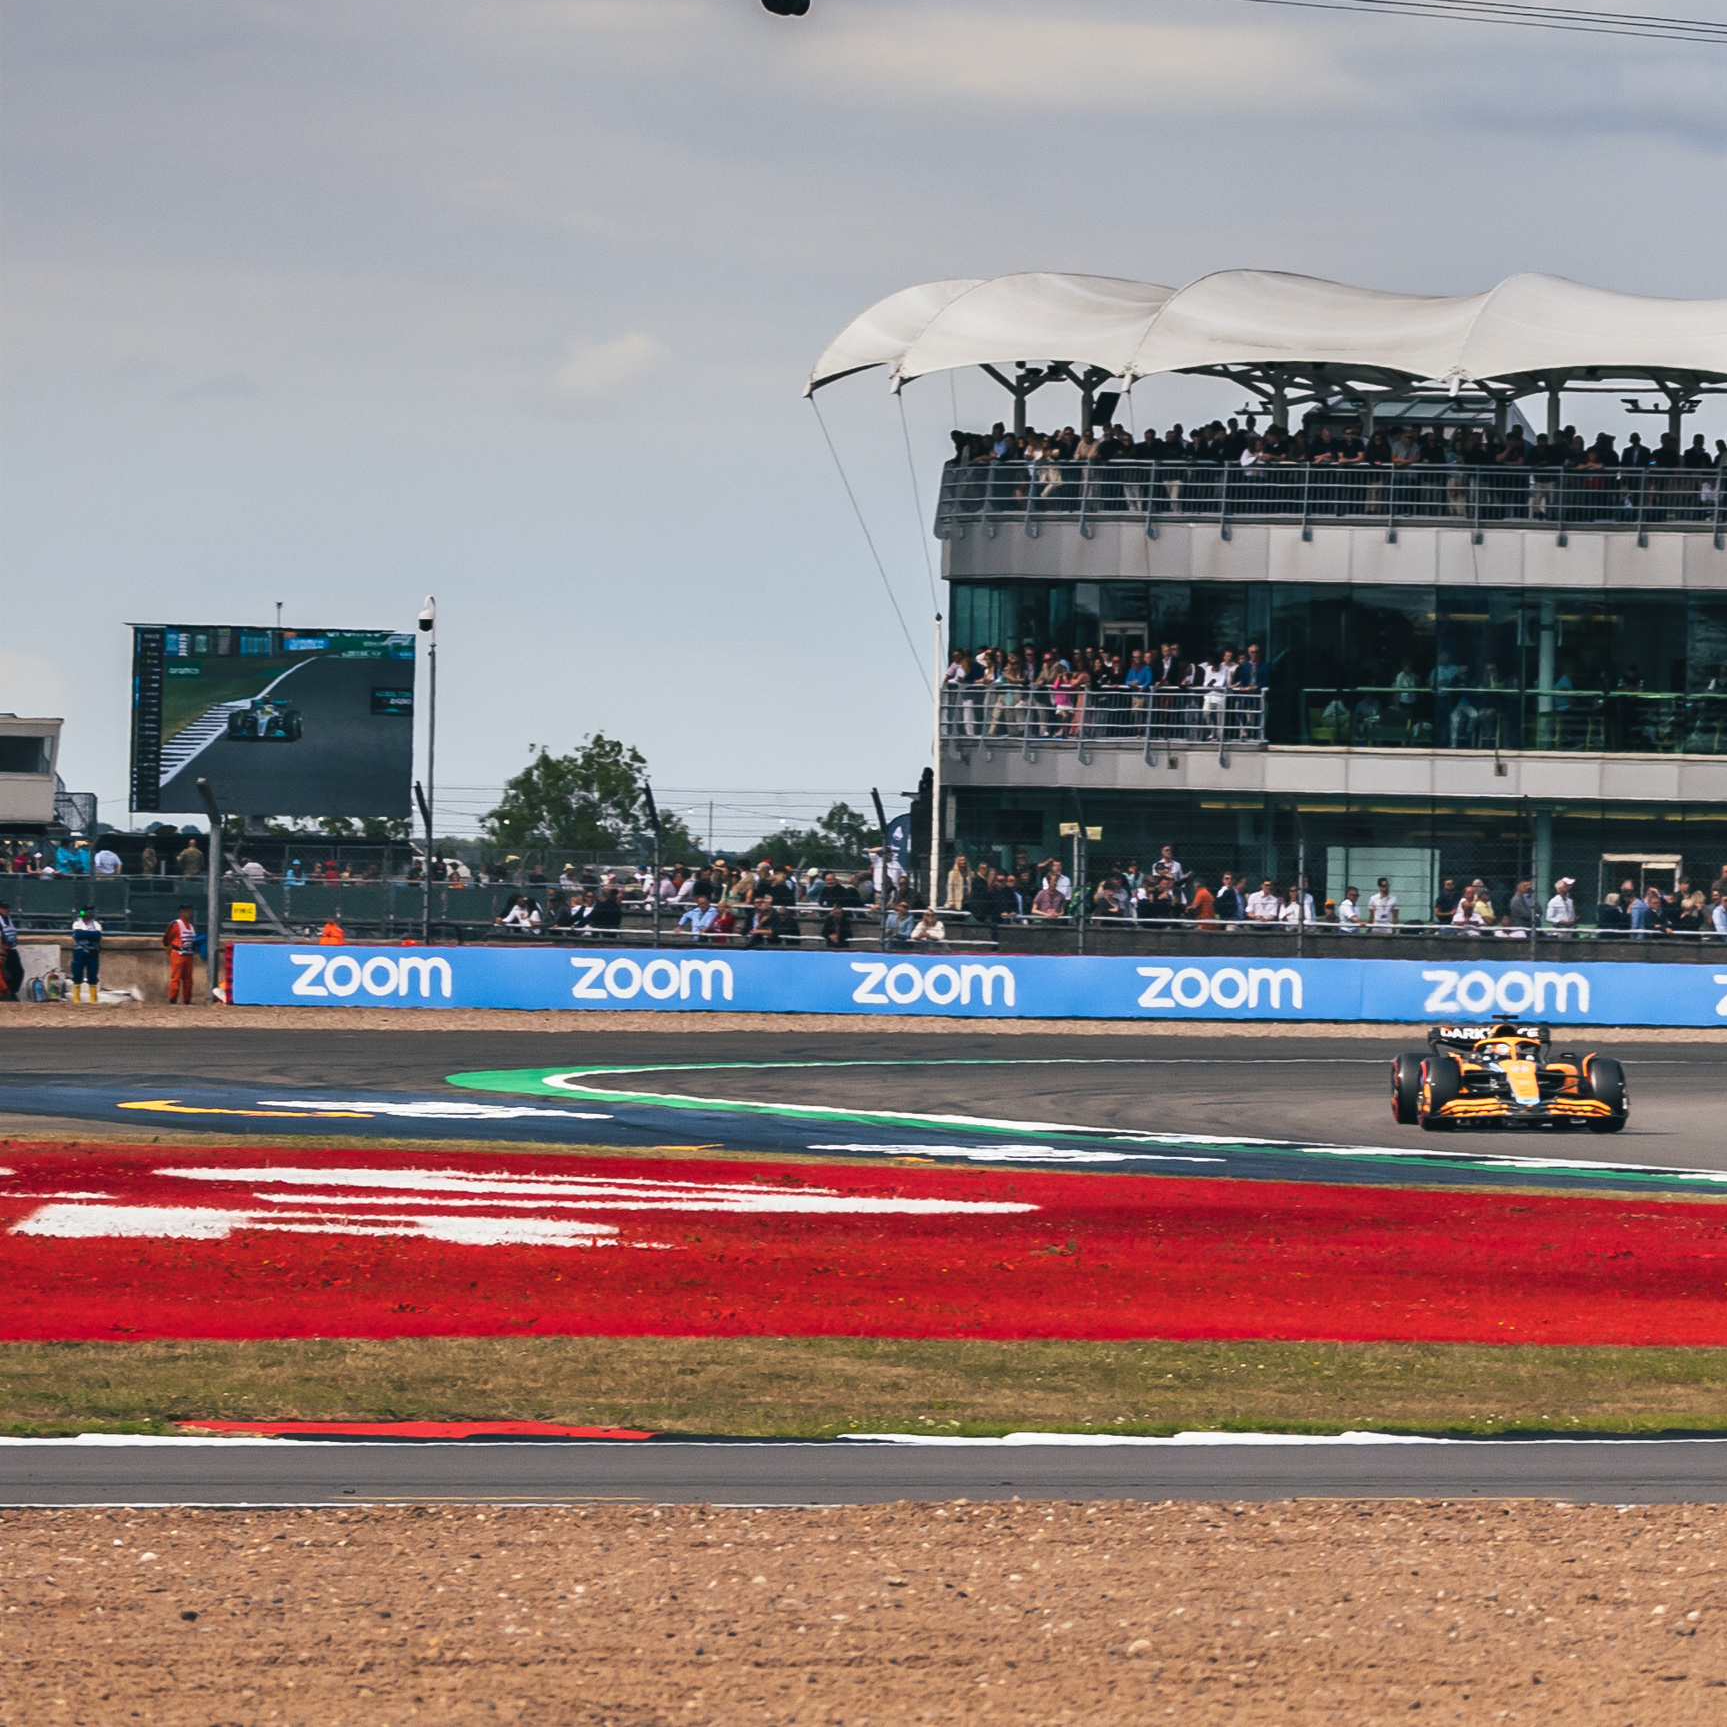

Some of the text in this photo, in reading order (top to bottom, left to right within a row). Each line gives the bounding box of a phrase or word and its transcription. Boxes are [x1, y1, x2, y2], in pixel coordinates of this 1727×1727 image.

[291, 955, 451, 997] zoom
[571, 958, 732, 999] zoom
[851, 963, 1014, 1006] zoom
[1137, 967, 1302, 1008] zoom
[1423, 970, 1589, 1012] zoom
[1440, 1027, 1540, 1040] DARKCE
